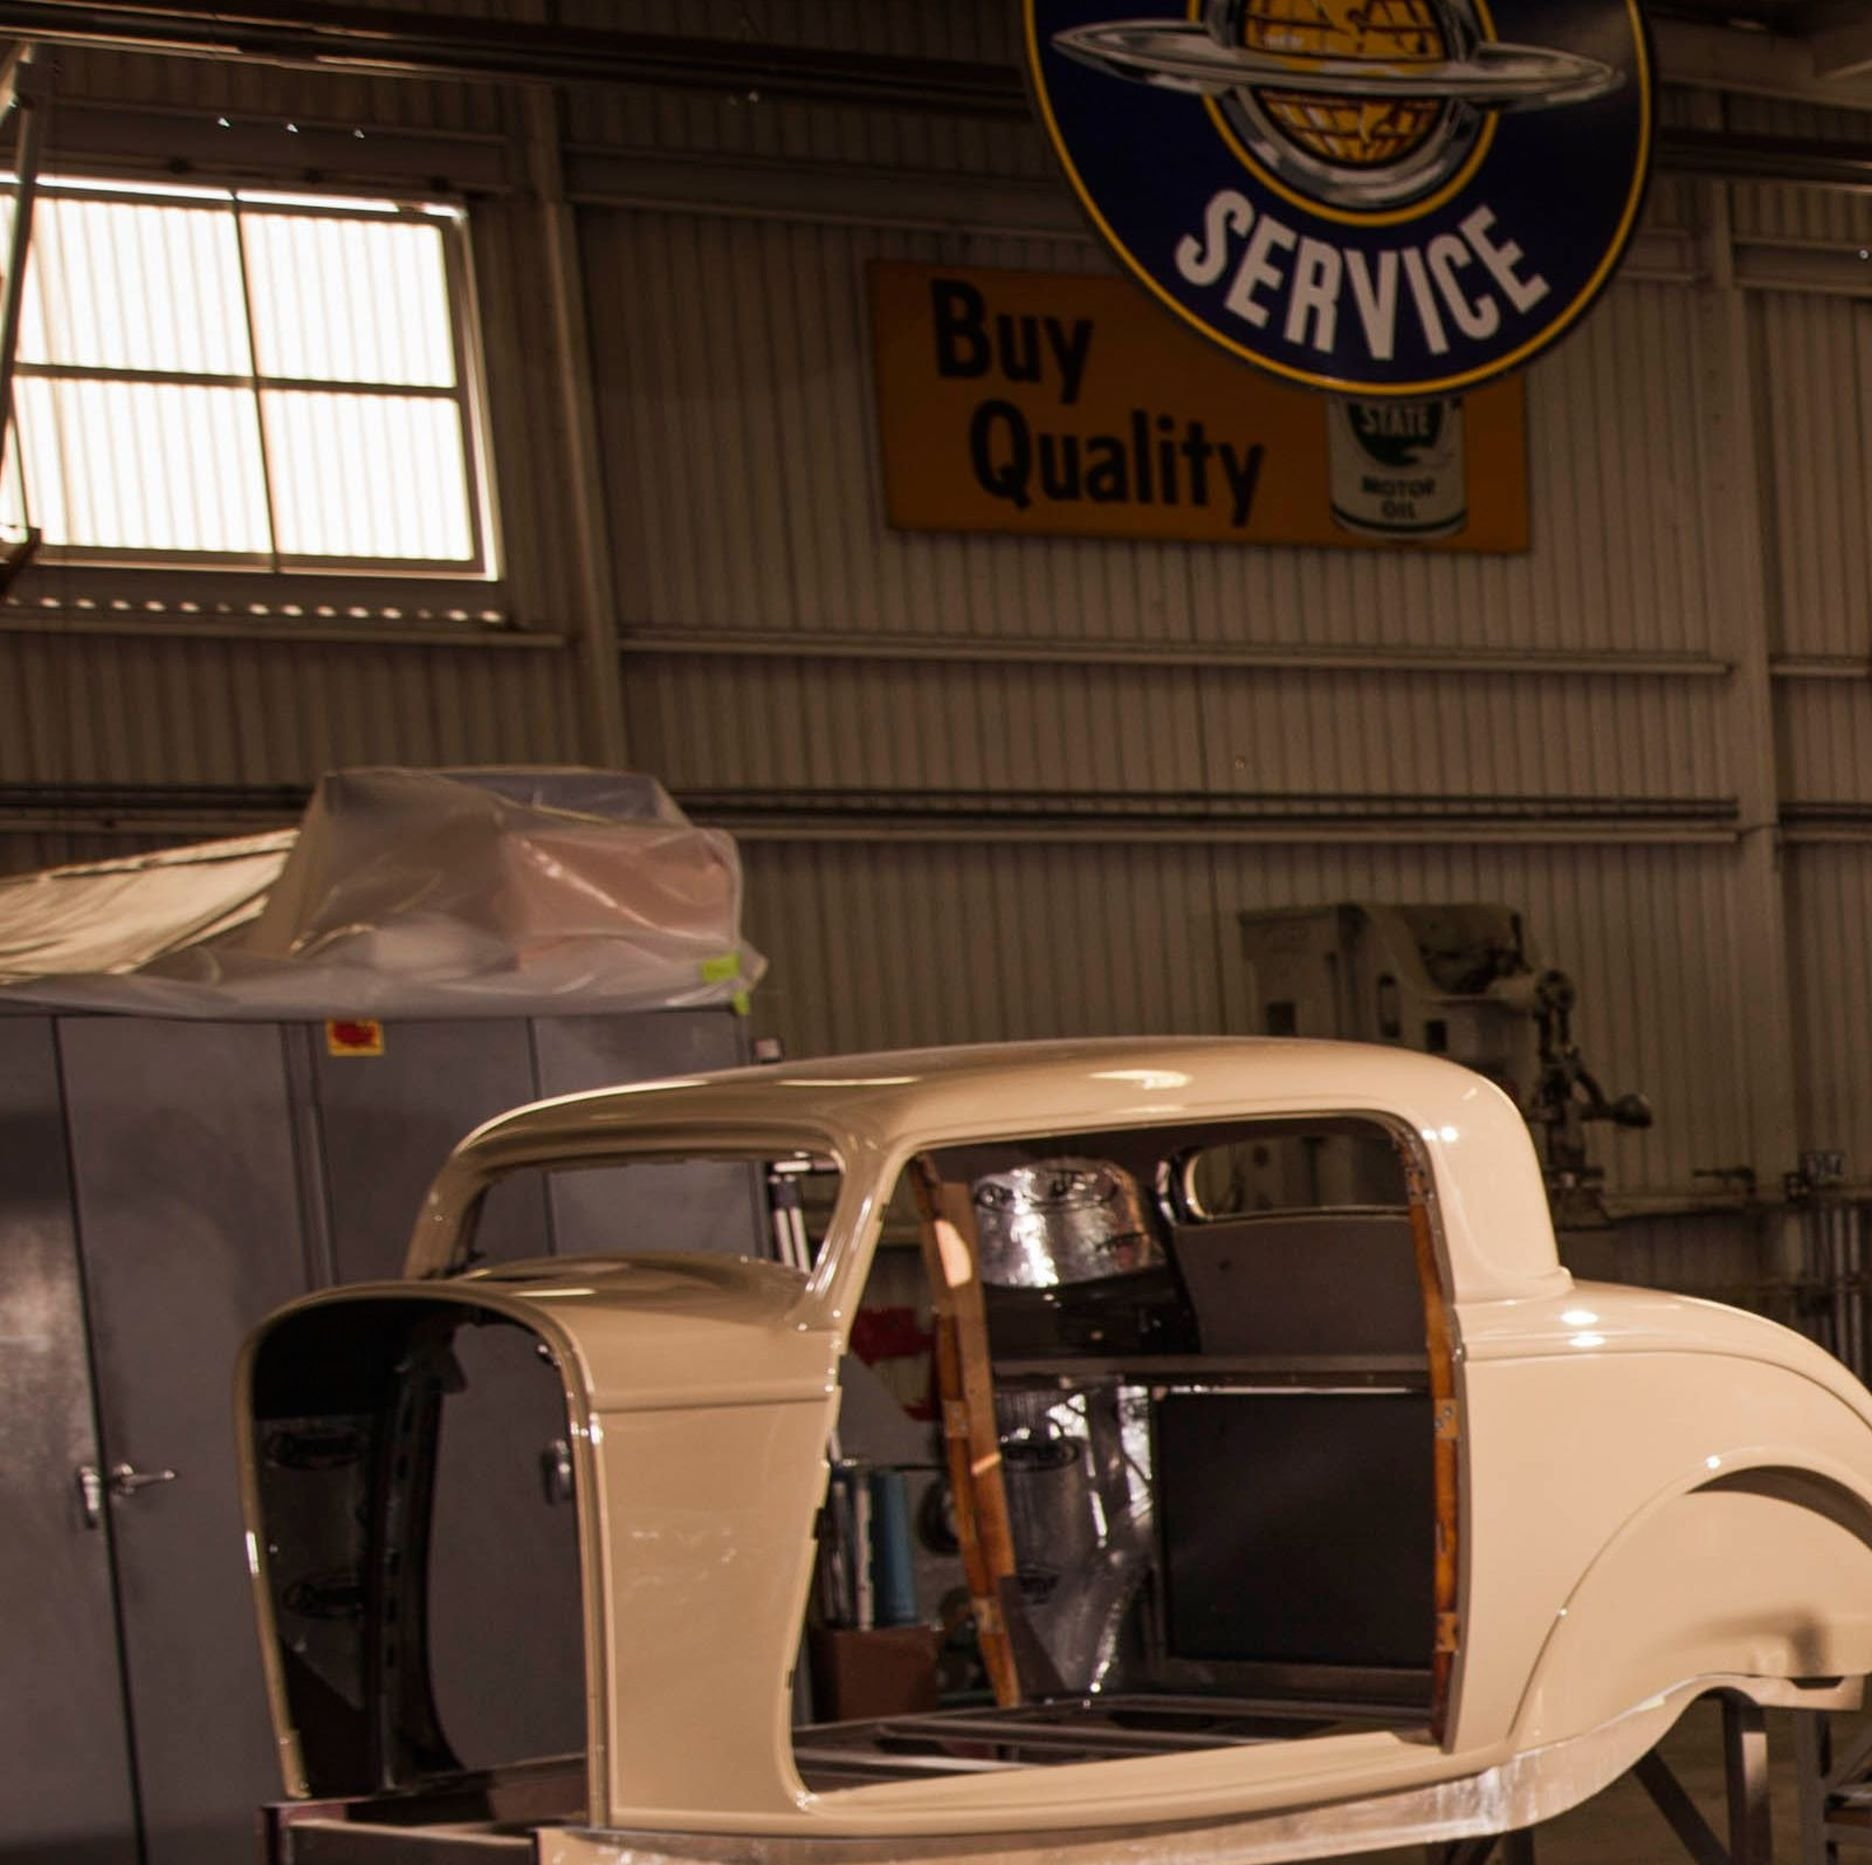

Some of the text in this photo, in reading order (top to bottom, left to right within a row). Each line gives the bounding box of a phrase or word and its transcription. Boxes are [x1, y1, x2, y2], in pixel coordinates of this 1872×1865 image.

[1173, 187, 1551, 361] SERVICE
[930, 278, 1095, 403] Buy
[969, 399, 1265, 528] Quality
